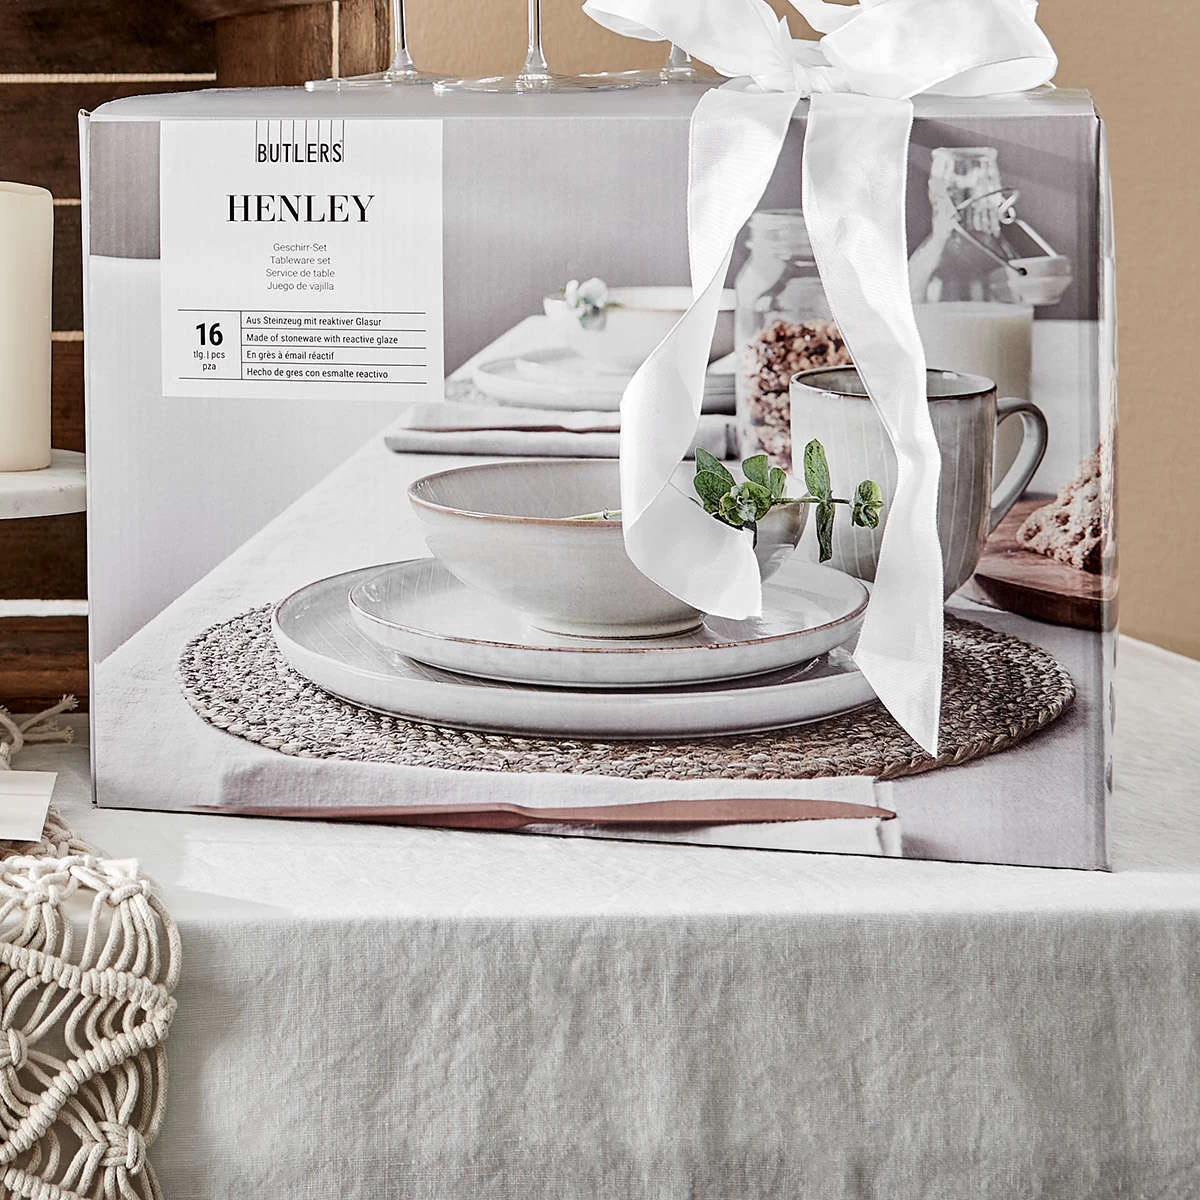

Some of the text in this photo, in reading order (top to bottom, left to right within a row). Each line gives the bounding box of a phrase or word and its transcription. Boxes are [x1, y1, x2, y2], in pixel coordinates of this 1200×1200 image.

[257, 143, 342, 163] BUTLERS
[226, 194, 375, 223] HENLEY
[272, 243, 327, 252] Geschirr-Set
[270, 255, 331, 264] Tableware set
[266, 268, 335, 277] Service de table
[267, 281, 334, 292] Juego de vajilla
[246, 316, 382, 327] Aus Steinzeug mit reaktiver Glasur
[196, 322, 223, 346] 16
[246, 333, 399, 345] Made of stoneware with reactive glaze
[211, 352, 226, 360] pcs
[247, 350, 335, 360] En grès à émail réactif
[202, 363, 217, 372] pza
[247, 368, 272, 376] Hecho
[274, 368, 284, 376] de
[286, 370, 303, 378] gres
[322, 369, 354, 378] esmalte
[355, 369, 389, 379] reactivo
